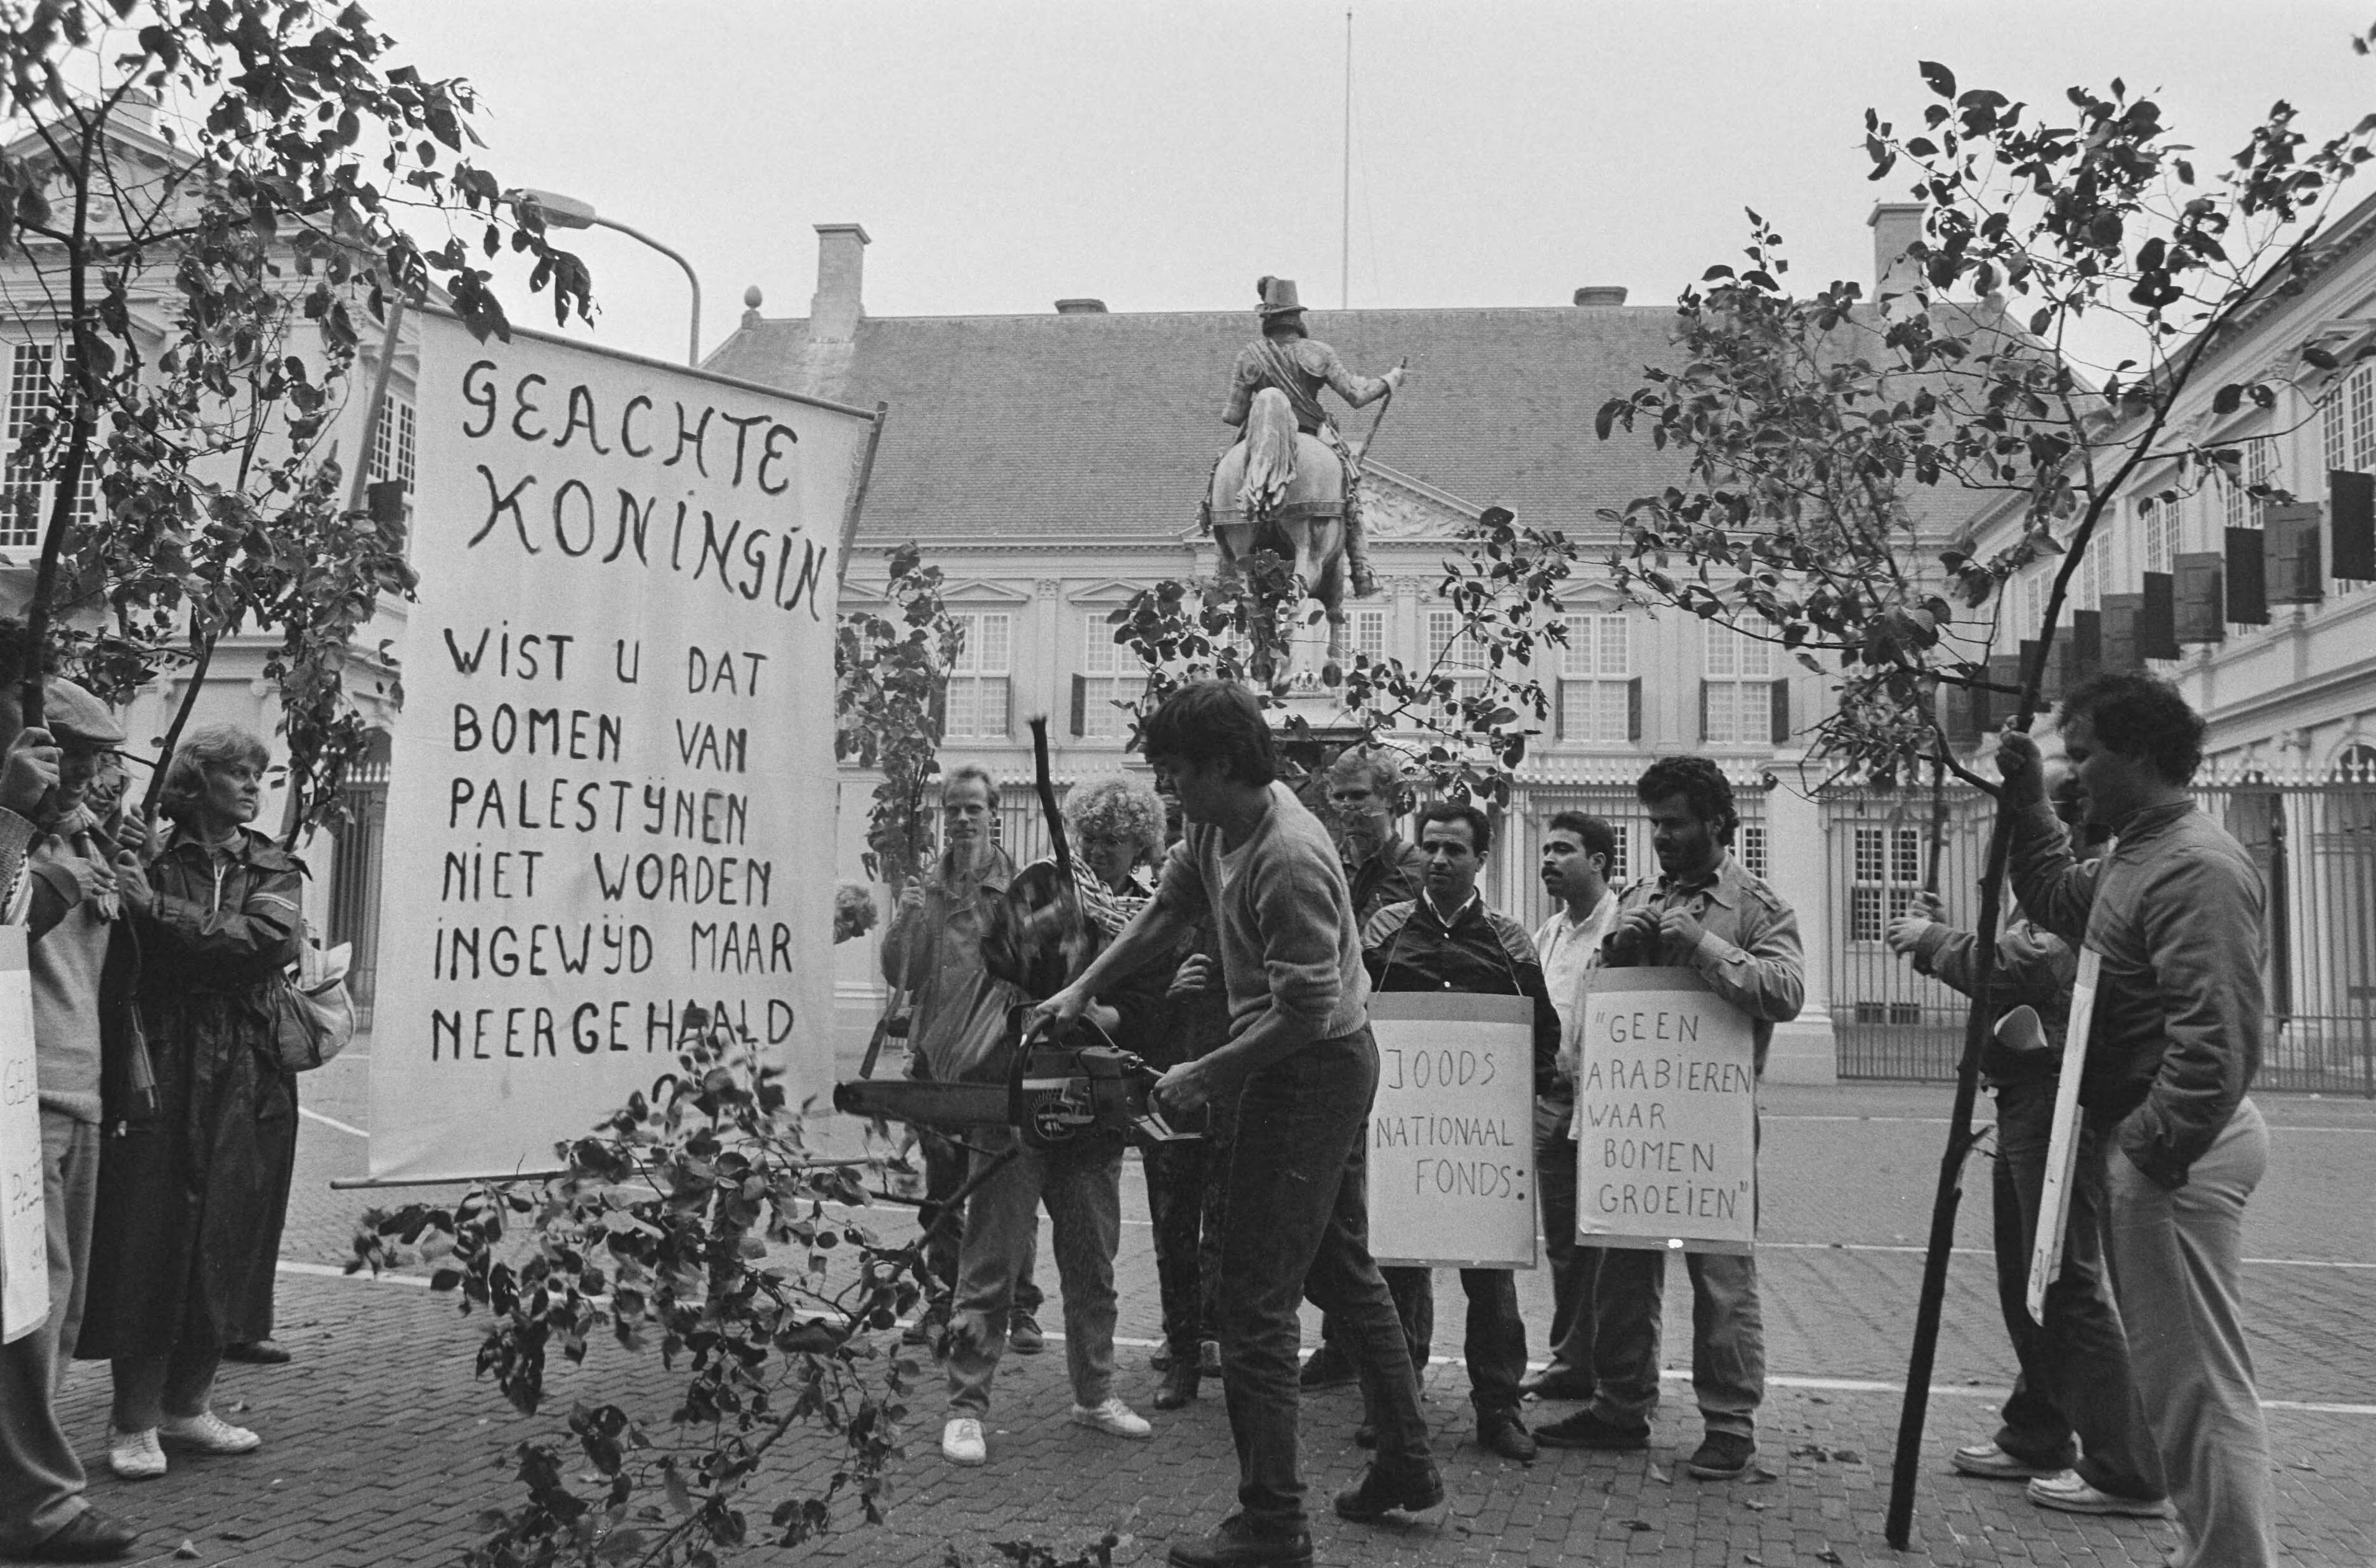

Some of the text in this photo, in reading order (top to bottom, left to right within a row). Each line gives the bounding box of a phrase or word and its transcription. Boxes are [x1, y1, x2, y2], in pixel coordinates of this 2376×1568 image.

[463, 359, 798, 495] GEACHTE
[468, 464, 827, 622] KONINGIN
[443, 620, 768, 696] WIST U DAT
[454, 703, 747, 773] BOMEN VAN
[442, 842, 772, 908] NIET WORDEN
[692, 921, 793, 975] MAAR
[431, 998, 795, 1062] NEERGEHAALD
[1595, 1011, 1699, 1043] "GEEN
[1386, 1049, 1496, 1090] JOODS
[1585, 1054, 1752, 1094] ARABIEREN
[1376, 1113, 1514, 1149] NATIONAAL
[1588, 1102, 1666, 1130] WAAR
[1603, 1138, 1714, 1173] BOMEN
[1415, 1158, 1525, 1201] FONDS:
[1598, 1179, 1749, 1220] GROEIEN"
